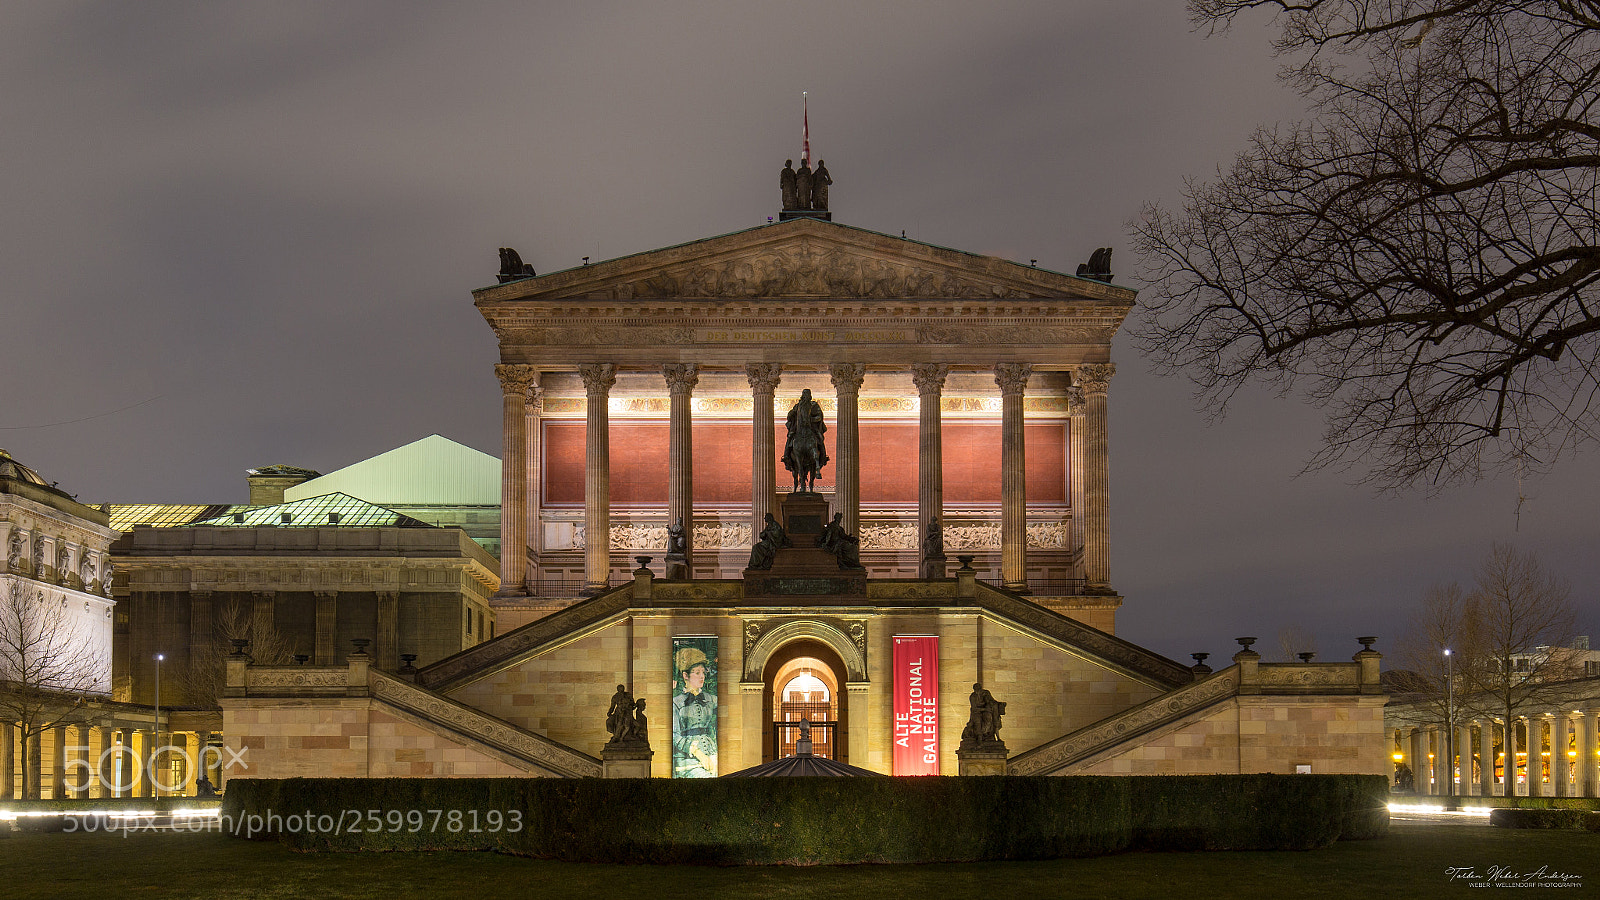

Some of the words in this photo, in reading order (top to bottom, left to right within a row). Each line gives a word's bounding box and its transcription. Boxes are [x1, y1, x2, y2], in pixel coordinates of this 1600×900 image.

[707, 331, 729, 341] DER
[734, 331, 797, 341] DEUTSCHEN
[802, 331, 836, 341] KUNST
[910, 658, 923, 734] NATIONAL
[896, 713, 909, 747] ALTE
[923, 698, 936, 764] GALERIE
